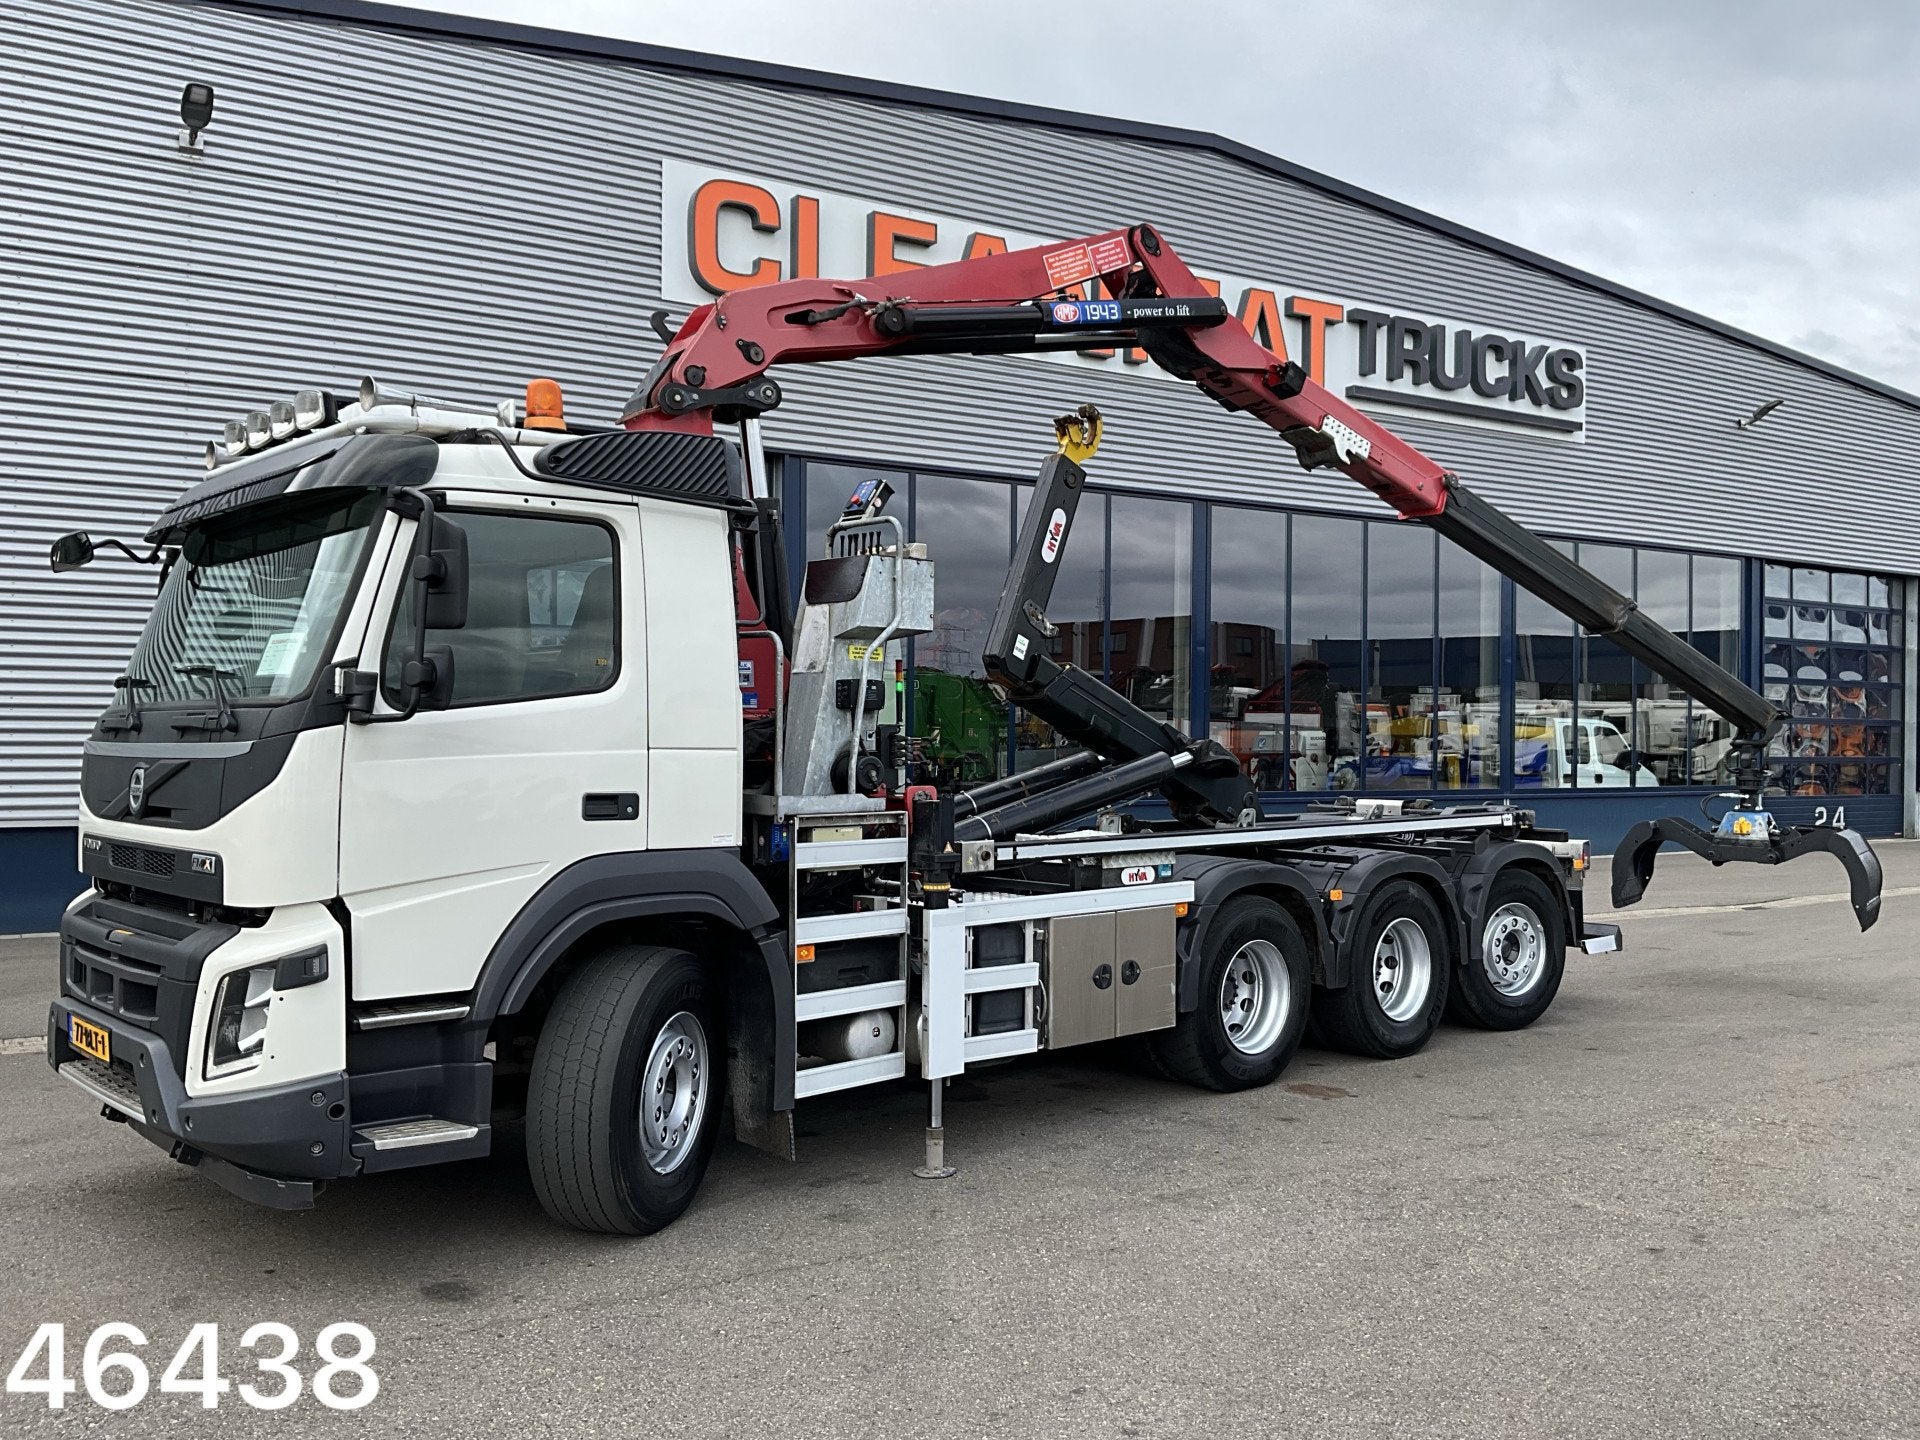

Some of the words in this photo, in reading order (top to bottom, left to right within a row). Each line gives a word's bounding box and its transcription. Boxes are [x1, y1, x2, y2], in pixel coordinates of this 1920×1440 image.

[1056, 304, 1076, 321] HMF
[1085, 304, 1119, 320] 1943
[1133, 307, 1162, 318] power
[1165, 306, 1174, 316] to
[1176, 304, 1190, 316] lift
[1346, 308, 1584, 410] TRUCKS
[1047, 522, 1063, 553] HYVA
[1815, 806, 1846, 829] 24
[1128, 868, 1148, 882] HYVA
